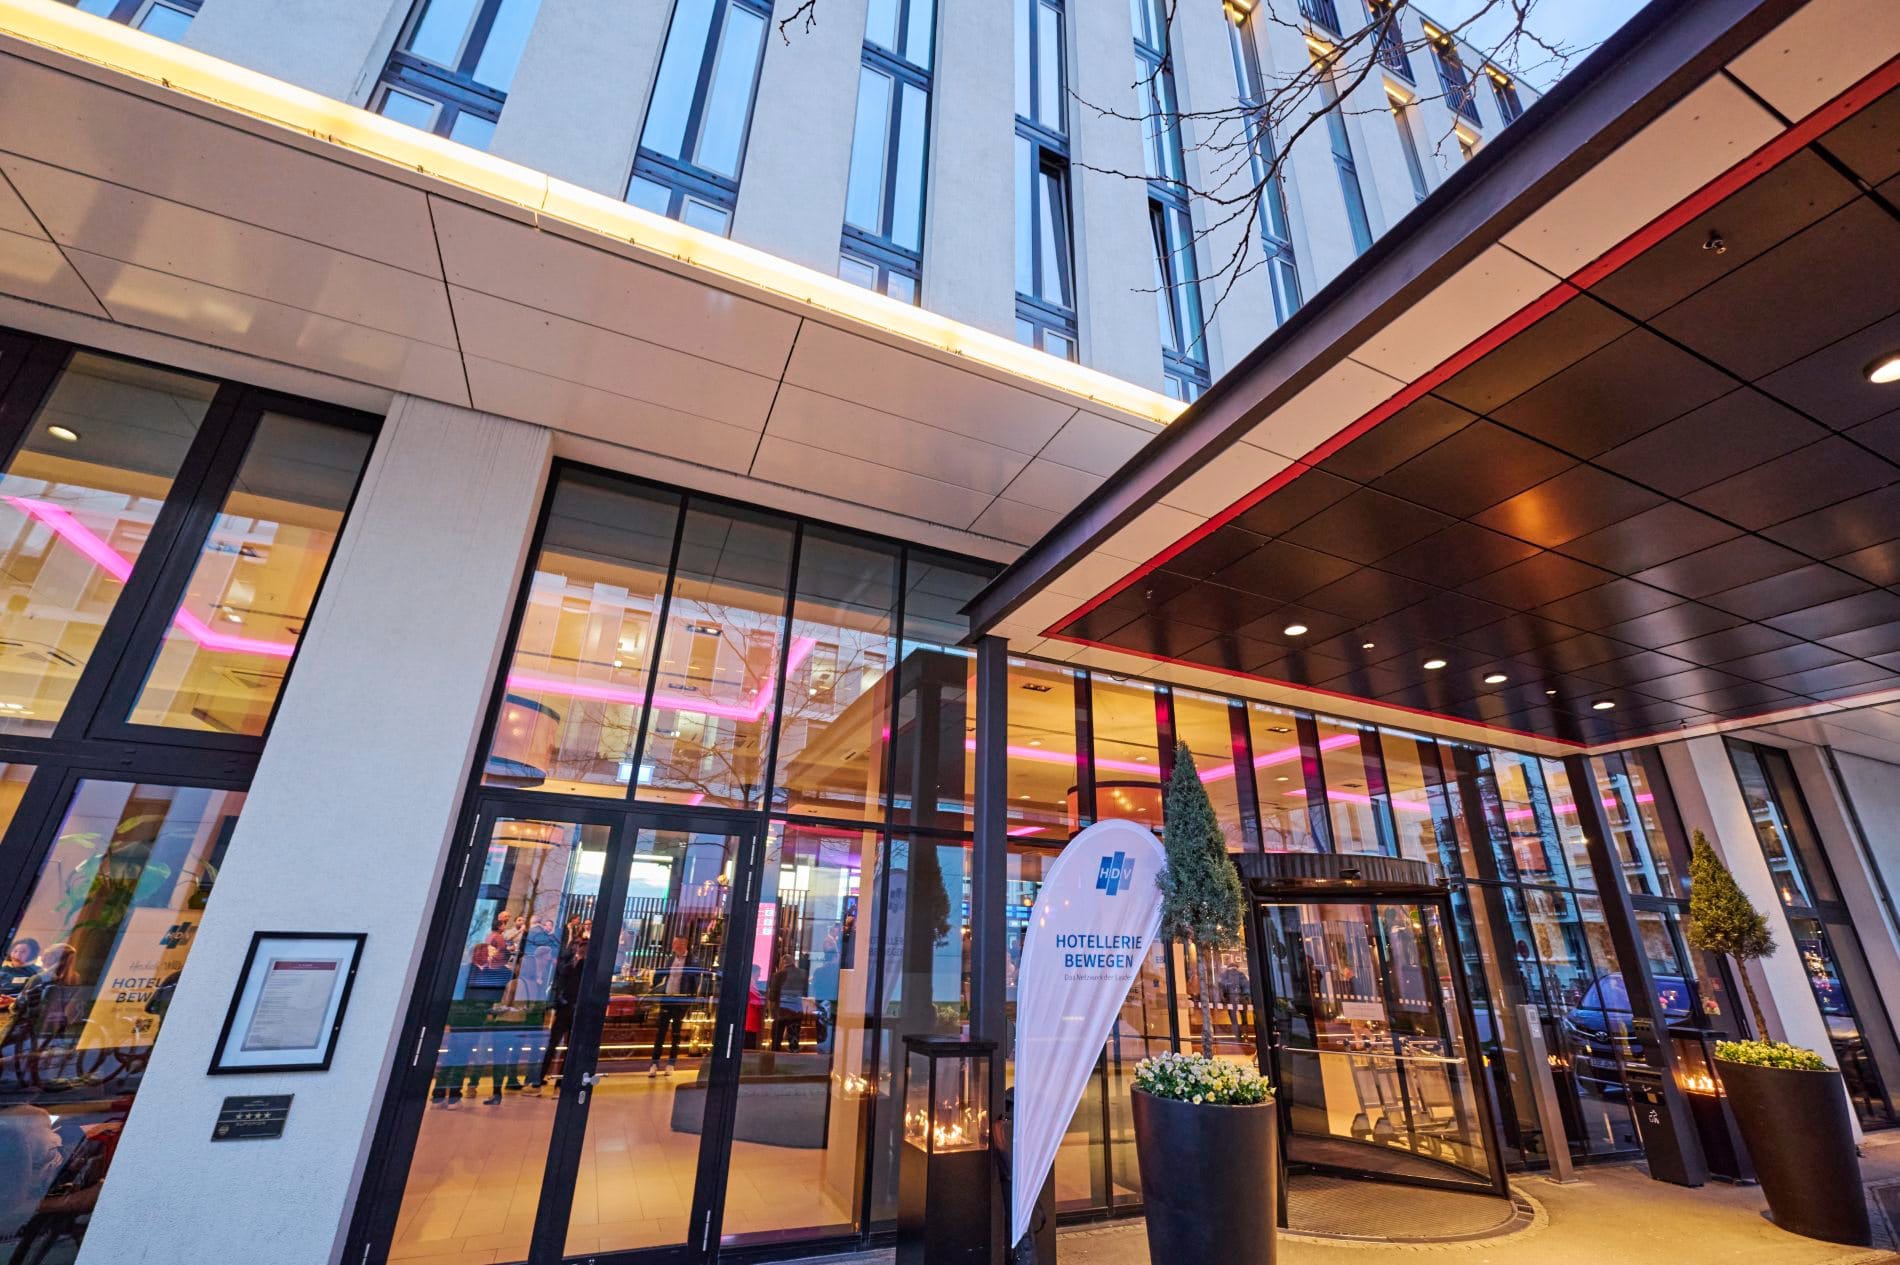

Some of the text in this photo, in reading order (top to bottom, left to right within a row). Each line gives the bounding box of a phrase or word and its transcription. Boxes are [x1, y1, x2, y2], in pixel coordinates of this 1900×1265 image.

[1100, 867, 1132, 879] HDV
[1056, 934, 1142, 949] HOTELLERIE
[1065, 954, 1134, 968] BEWEGEN
[112, 977, 162, 989] HOTEL
[116, 992, 152, 1003] BEW
